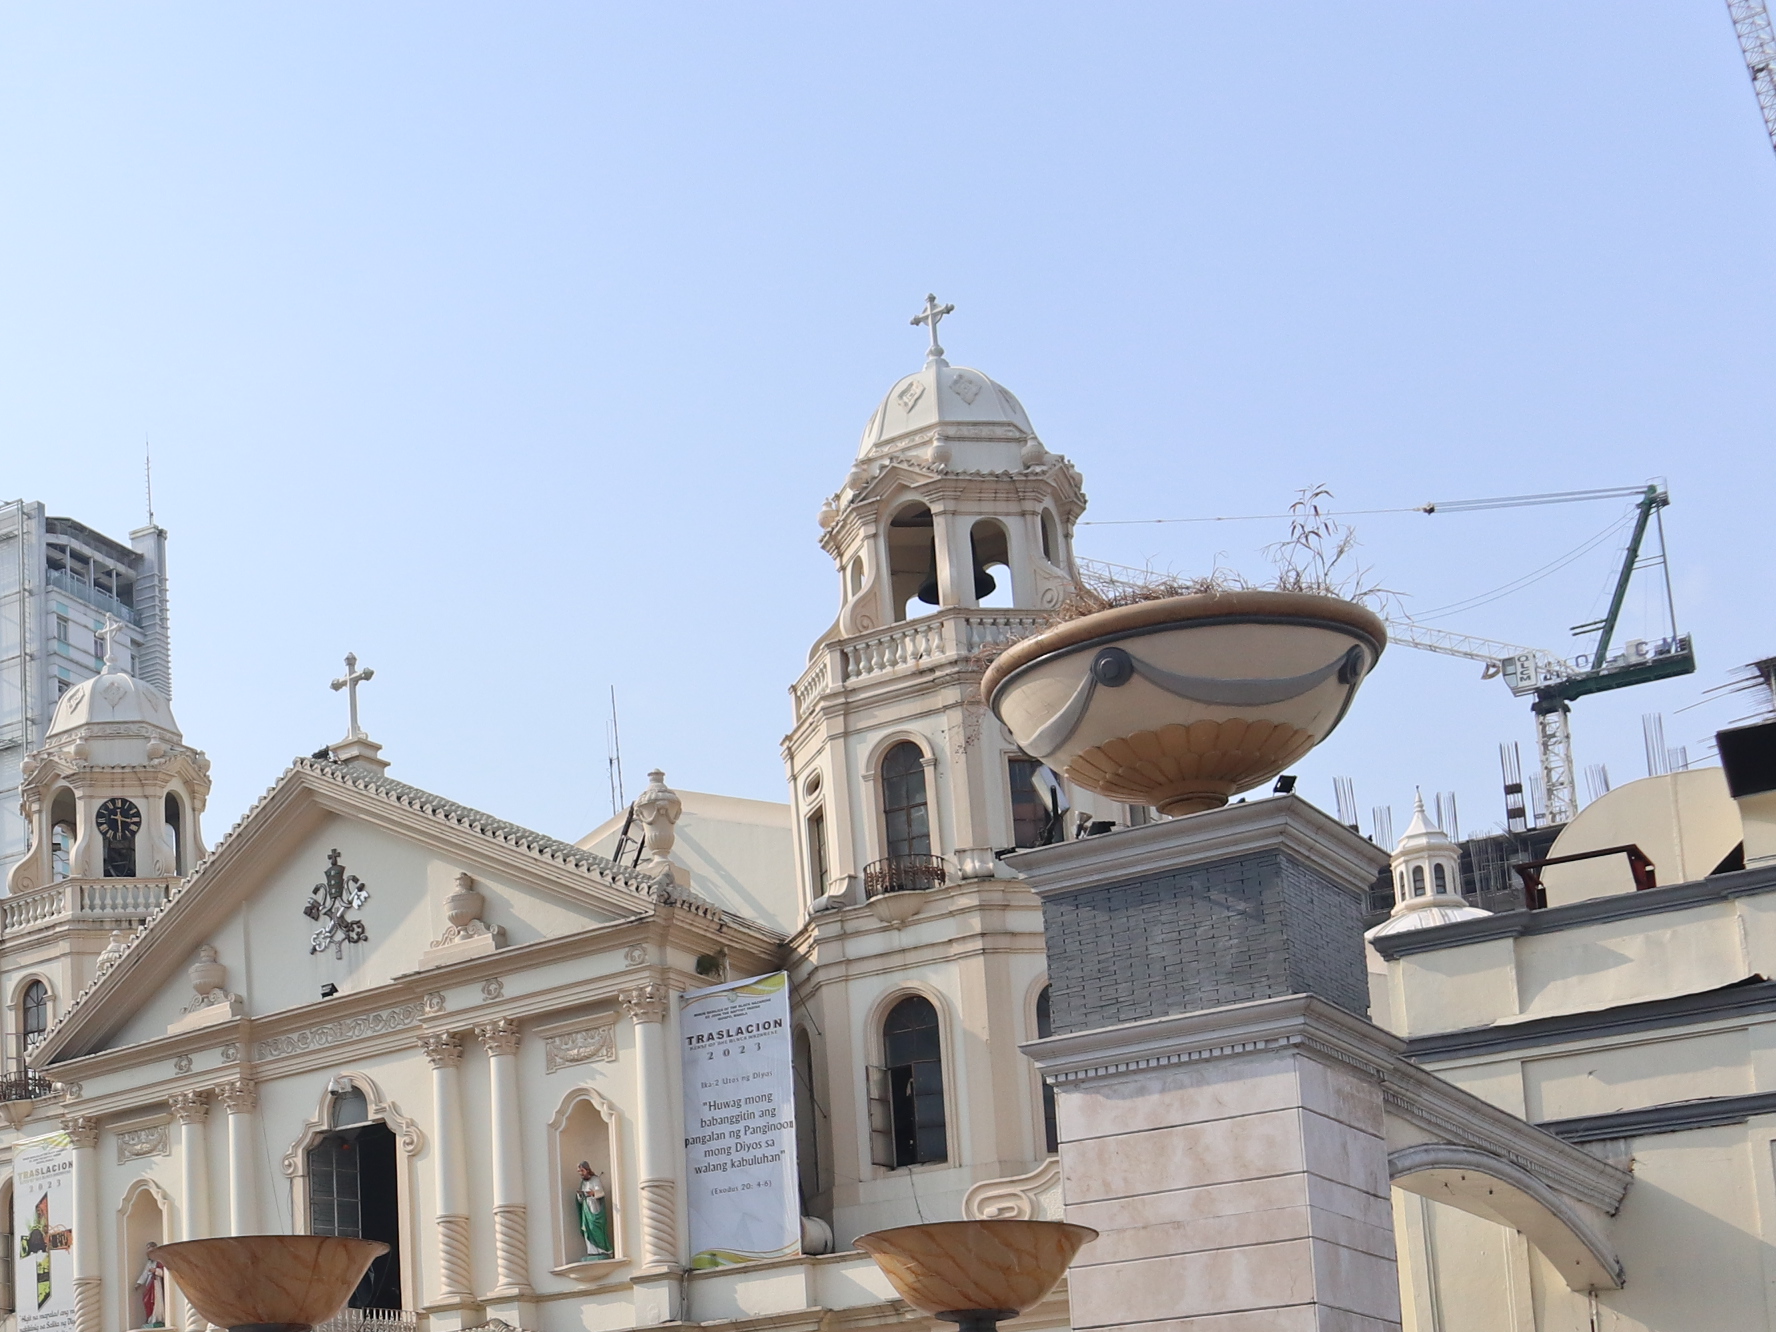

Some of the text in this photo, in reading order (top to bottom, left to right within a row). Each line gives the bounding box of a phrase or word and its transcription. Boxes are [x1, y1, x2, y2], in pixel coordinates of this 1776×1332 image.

[686, 1018, 782, 1046] TRASLACION
[703, 1093, 773, 1111] "Huwag mong
[701, 1107, 776, 1128] babanggitin ang
[685, 1131, 725, 1148] pangalan
[729, 1129, 741, 1139] ng
[704, 1139, 775, 1158] mong Diyos sa
[18, 1160, 73, 1180] TRASLACION
[695, 1150, 785, 1174] walang kabuluhan"
